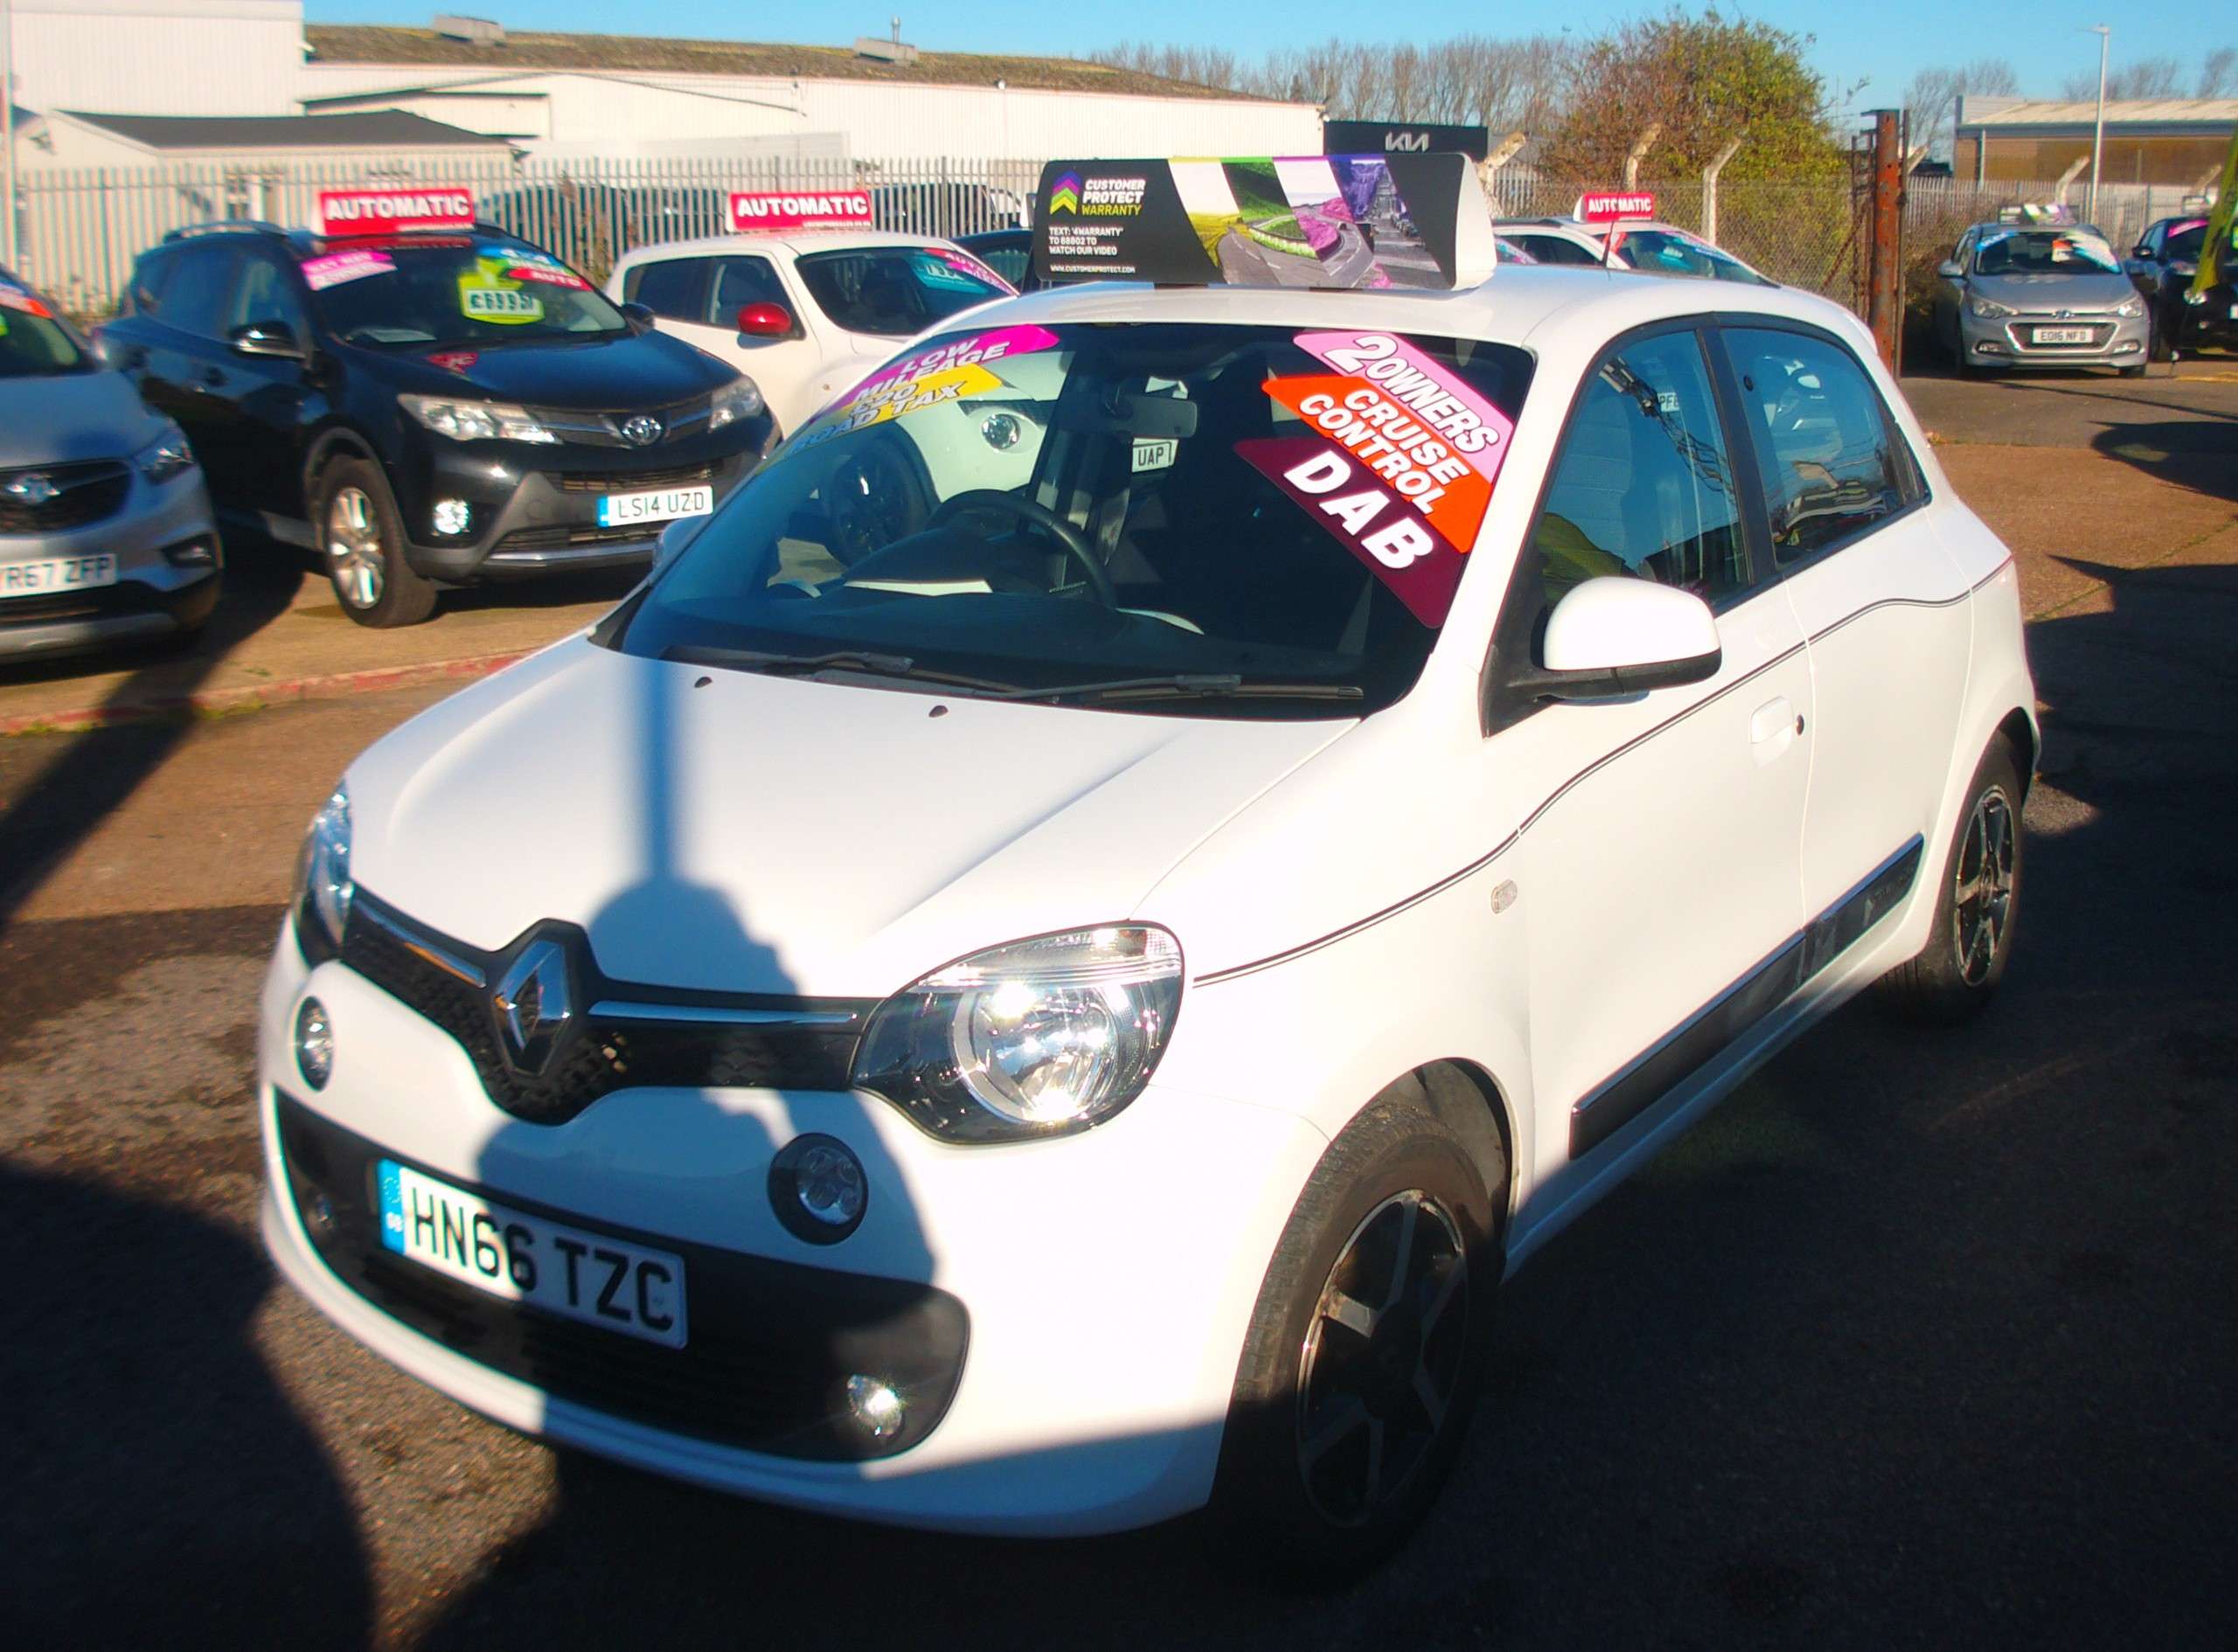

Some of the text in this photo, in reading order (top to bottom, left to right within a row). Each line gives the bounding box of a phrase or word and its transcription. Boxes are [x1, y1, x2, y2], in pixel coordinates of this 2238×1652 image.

[1385, 131, 1429, 152] KIA
[1082, 191, 1144, 204] PROTECT
[1085, 179, 1146, 191] CUSTOMER
[326, 195, 470, 220] AUTOMATIC
[737, 196, 868, 217] AUTOMATIC
[1081, 205, 1142, 216] WARRANTY
[1049, 237, 1060, 246] TO
[1086, 237, 1098, 246] TO
[1049, 246, 1118, 256] WATCH OUR VIDEO
[901, 338, 980, 372] LOW
[855, 341, 1011, 402] MILEAGE
[893, 381, 968, 415] TAX
[1366, 357, 1500, 454] OWNERS
[1343, 389, 1471, 485] CRUISE
[1137, 447, 1164, 467] UAP
[1298, 393, 1446, 515] CONTROL
[618, 492, 705, 518] LS14 UZD
[1282, 450, 1435, 569] DAB
[0, 564, 54, 588] R67
[412, 1186, 674, 1332] HN66 TZC
